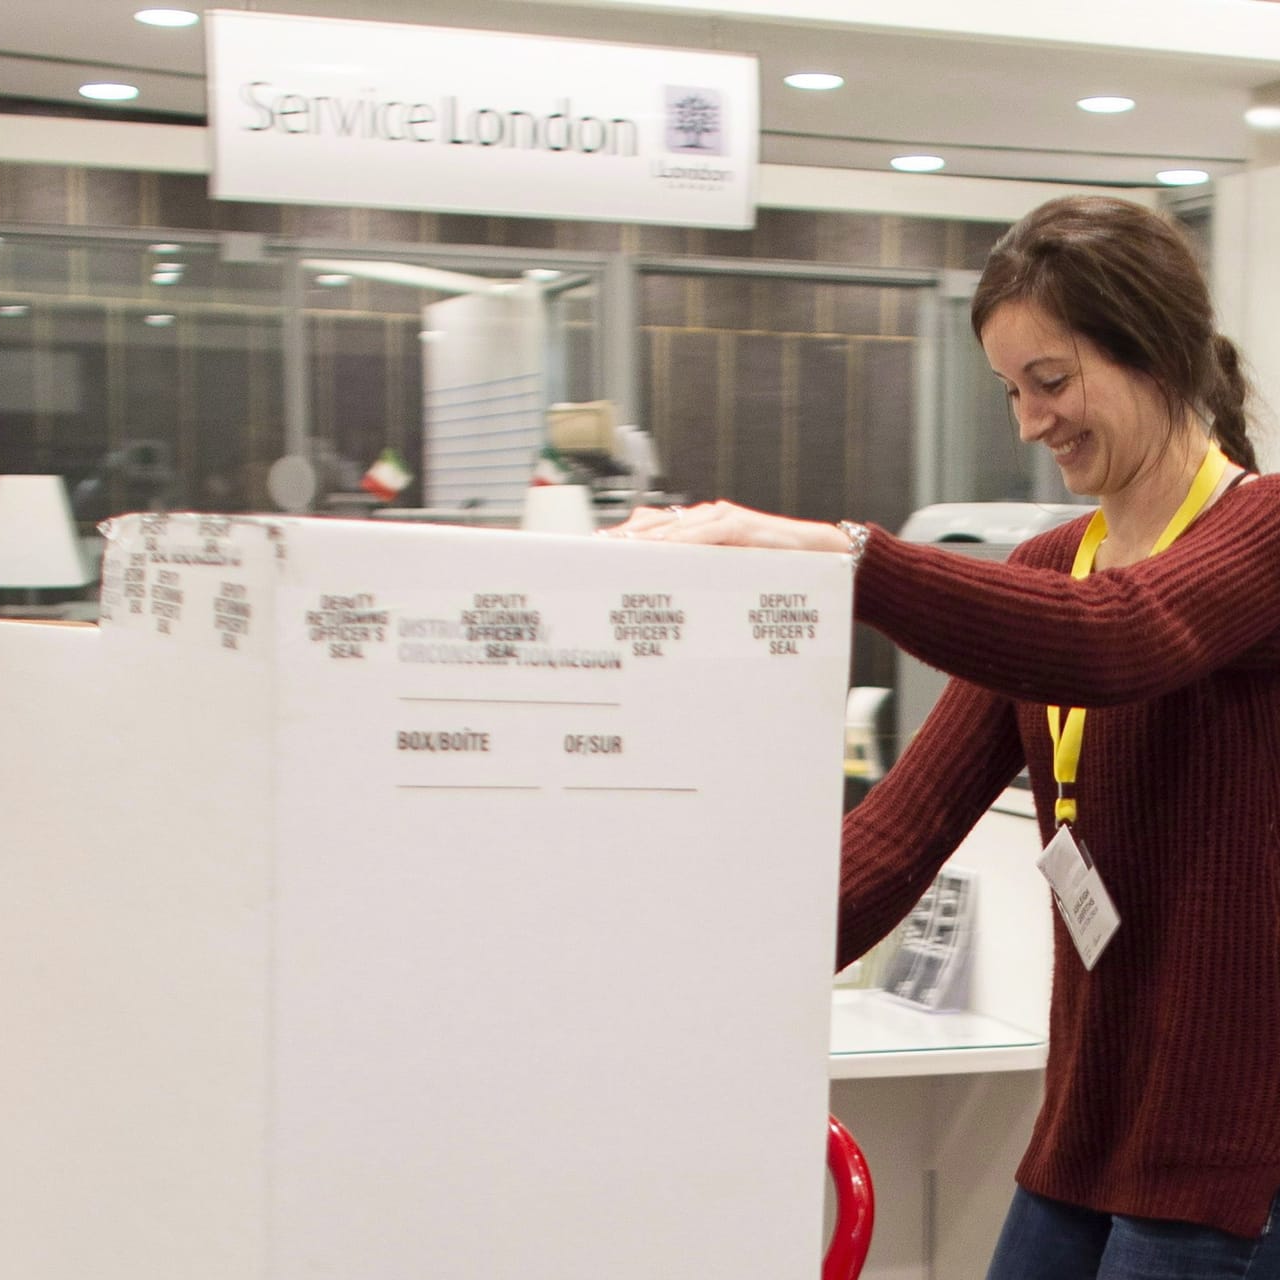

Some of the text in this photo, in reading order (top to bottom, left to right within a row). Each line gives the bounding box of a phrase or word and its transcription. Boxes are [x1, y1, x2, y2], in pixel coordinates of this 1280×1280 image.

[473, 593, 527, 609] DEPUTY
[622, 593, 672, 609] DEPUTY
[759, 593, 808, 608] DEPUTY
[461, 610, 540, 626] RETURNING
[610, 609, 685, 625] RETURNING
[748, 608, 819, 624] RETURNING
[614, 625, 682, 641] OFFICER'S
[752, 624, 816, 640] OFFICER'S
[329, 643, 365, 659] SEAL
[486, 643, 520, 659] SEAL
[632, 641, 664, 657] SEAL
[768, 640, 800, 655] SEAL
[397, 727, 490, 752] BOX/BOÎTE
[563, 733, 623, 754] OF/SUR
